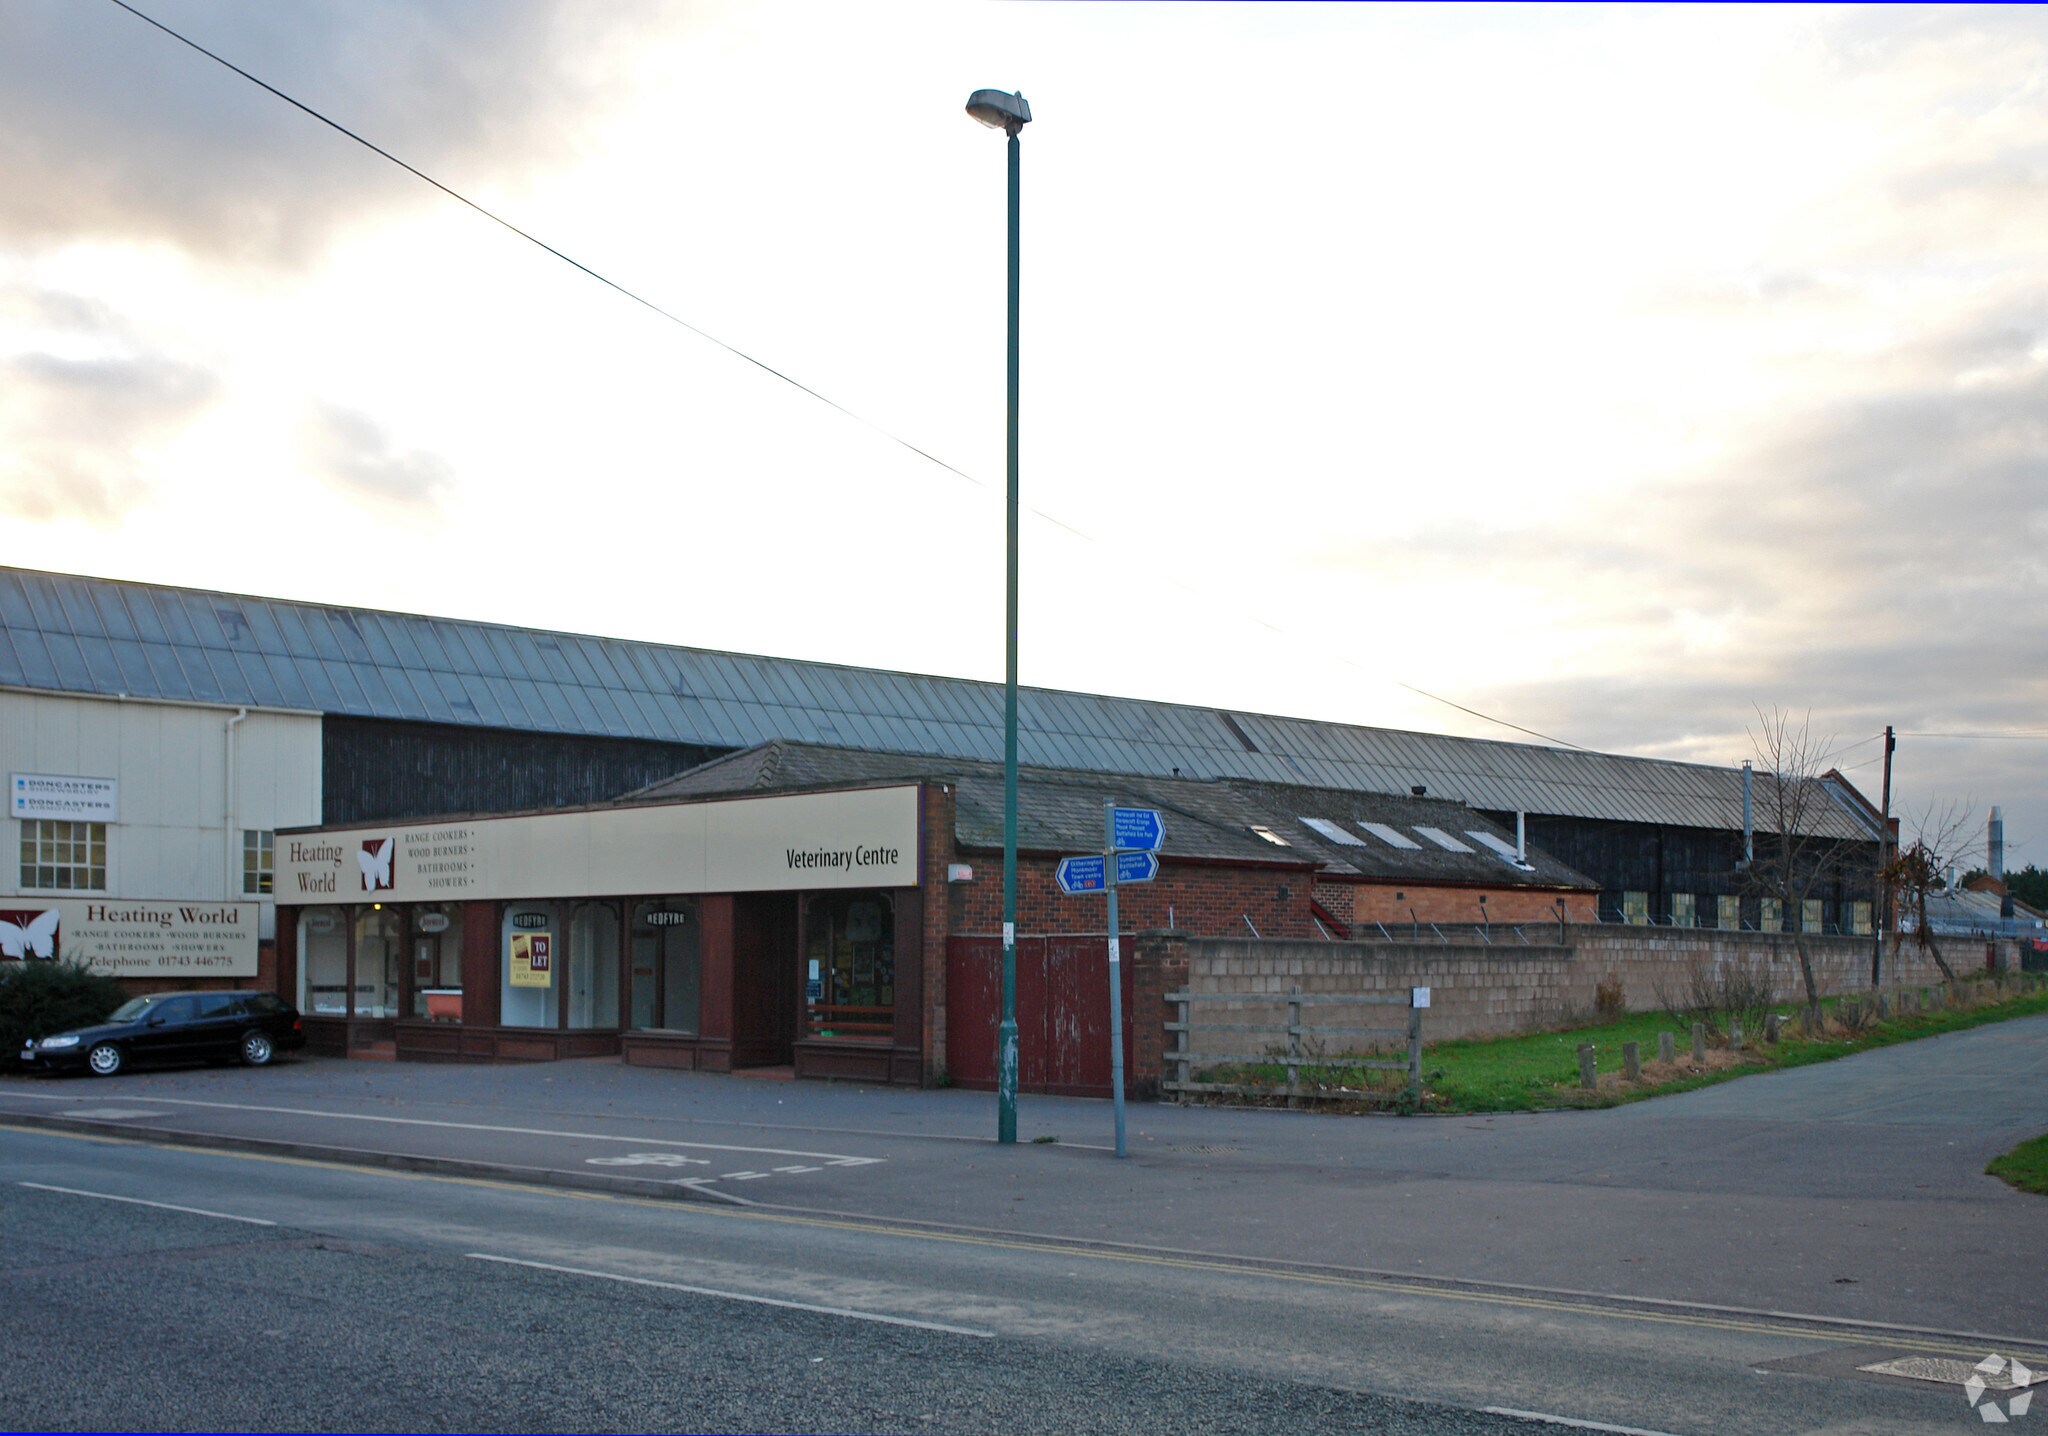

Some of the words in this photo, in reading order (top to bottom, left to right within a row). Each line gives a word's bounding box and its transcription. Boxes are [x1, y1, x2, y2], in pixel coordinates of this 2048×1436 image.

[28, 780, 110, 790] DONCASTERS
[29, 786, 99, 795] SHREWSBURY
[28, 799, 110, 808] DONCASTERS
[405, 832, 430, 844] RANGE
[432, 829, 468, 842] COOKERS
[290, 841, 343, 867] Heating
[408, 848, 431, 859] WOOD
[433, 845, 468, 858] BURNERS
[786, 848, 852, 872] Veterinary
[855, 845, 898, 866] Centre
[417, 862, 468, 874] BATHROOMS
[298, 872, 336, 893] World
[428, 877, 468, 889] SHOWERS
[87, 904, 173, 928] Heating
[178, 907, 239, 924] World
[647, 912, 685, 925] REDFYRE
[74, 930, 109, 939] RANGE
[114, 931, 161, 939] COOKERS
[203, 932, 246, 940] BURNERS
[98, 943, 165, 951] BATHROOMS
[175, 944, 225, 952] SHOWERS
[534, 941, 546, 953] TO
[88, 955, 151, 969] Telephone
[158, 956, 191, 966] 01743
[193, 956, 233, 966] 446775
[532, 956, 548, 967] LET
